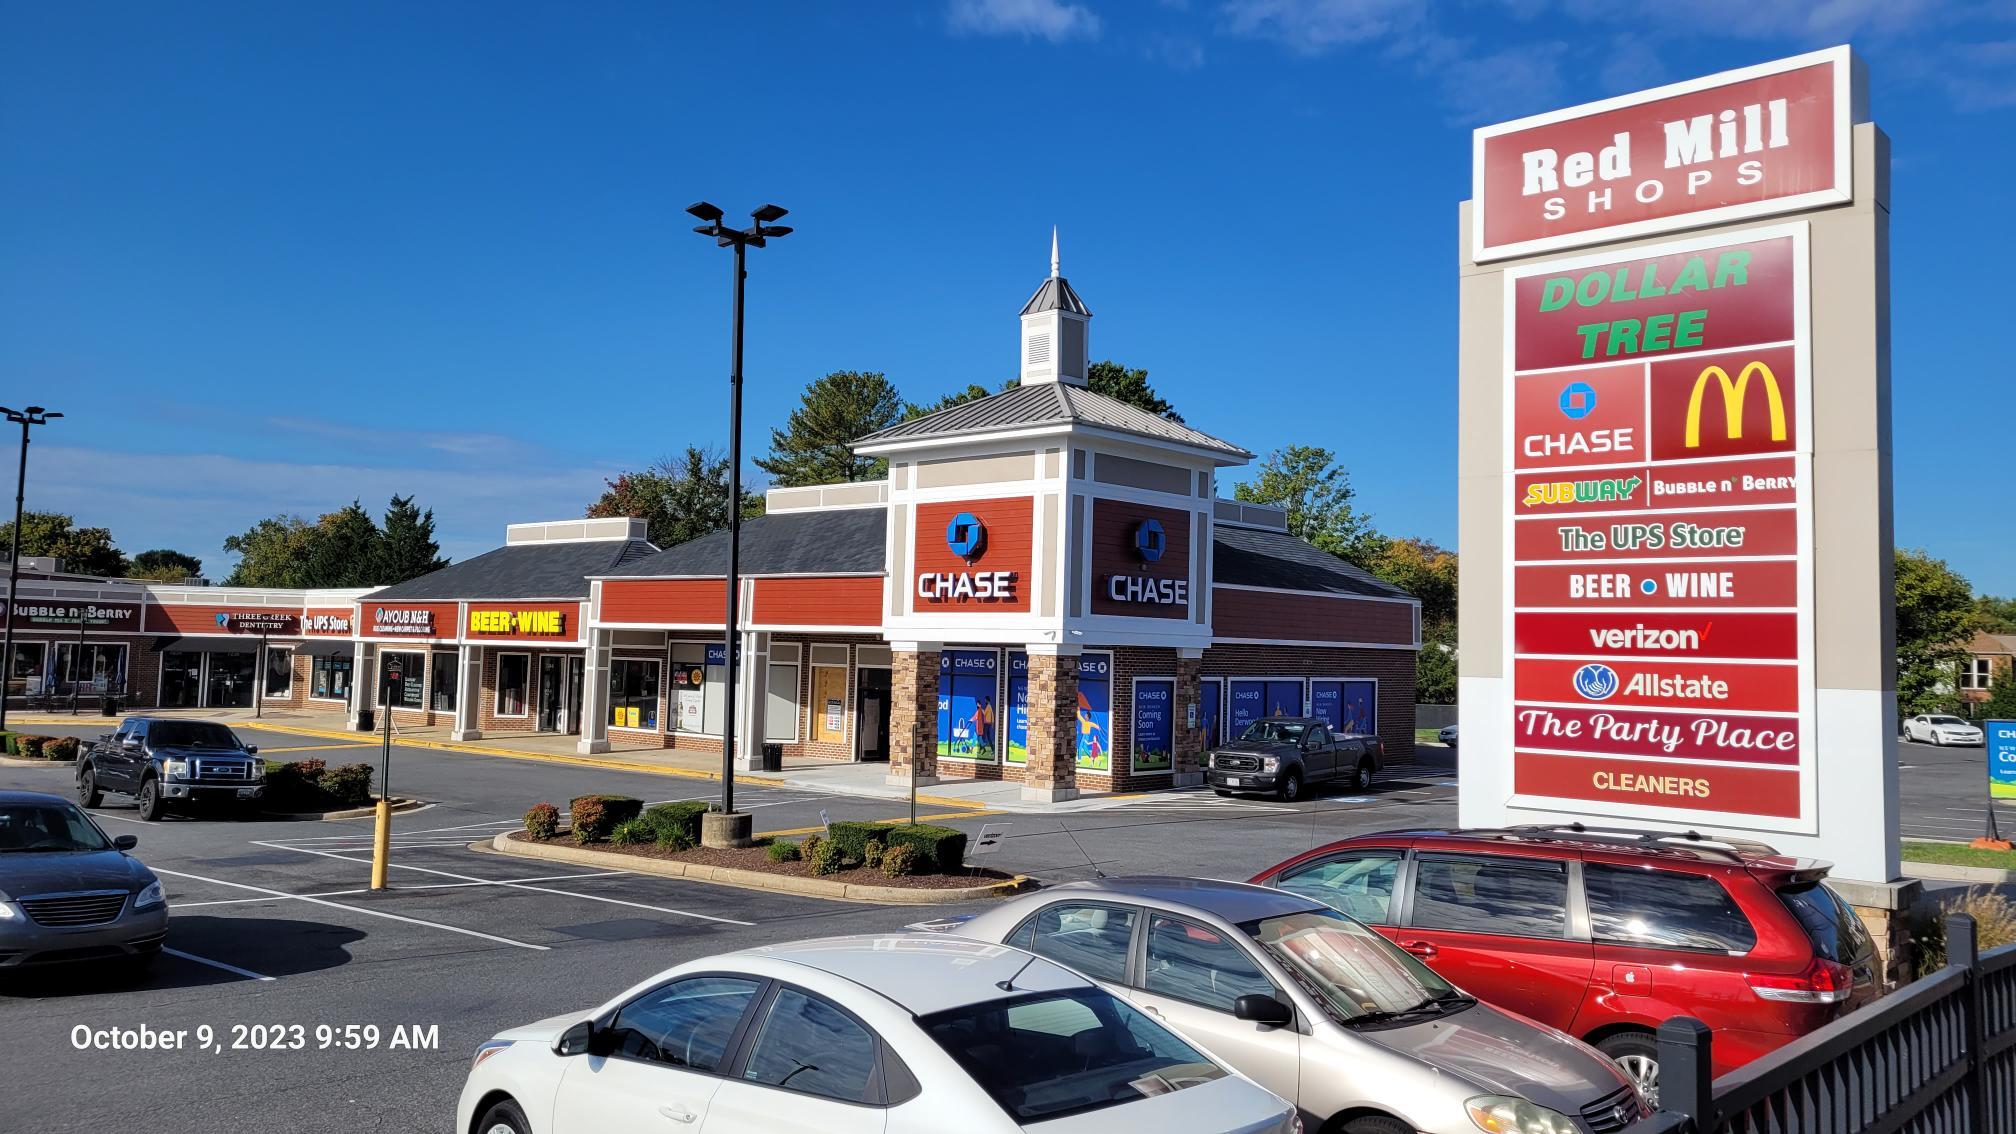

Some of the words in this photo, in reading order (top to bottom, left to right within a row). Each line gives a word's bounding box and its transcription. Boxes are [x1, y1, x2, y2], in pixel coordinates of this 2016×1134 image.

[1522, 131, 1631, 196] Red
[1664, 98, 1789, 169] Mill
[1543, 160, 1763, 220] SHOPS
[1539, 249, 1753, 313] DOLLAR
[1577, 309, 1708, 359] TREE
[1524, 427, 1634, 457] CHASE
[1522, 476, 1641, 507] SUBWAY
[1558, 526, 1605, 551] The
[1610, 523, 1665, 550] UPS
[1670, 523, 1744, 548] Store
[918, 572, 1012, 598] CHASE
[1110, 575, 1188, 605] CHASE
[1570, 574, 1631, 598] BEER
[1665, 572, 1734, 598] WINE
[300, 615, 312, 630] The
[314, 615, 329, 630] UPS
[329, 615, 348, 630] Store
[382, 611, 410, 624] AYOUB
[410, 611, 429, 624] N&H
[470, 611, 511, 632] BEER
[518, 611, 561, 633] WINE
[1590, 623, 1699, 650] verizon
[708, 650, 727, 659] CHAS
[955, 658, 985, 668] CHASE
[1013, 660, 1029, 669] CH
[1139, 691, 1160, 700] CHASE
[1235, 691, 1254, 699] CHASE
[1316, 691, 1333, 699] CHASE
[1623, 673, 1729, 699] Allstate
[1137, 719, 1154, 729] Soon
[1138, 710, 1162, 721] Coming
[1235, 708, 1249, 717] Hello
[1519, 710, 1582, 738] The
[1589, 712, 1684, 752] Party
[1690, 718, 1796, 751] Place
[1592, 771, 1710, 798] CLEANERS
